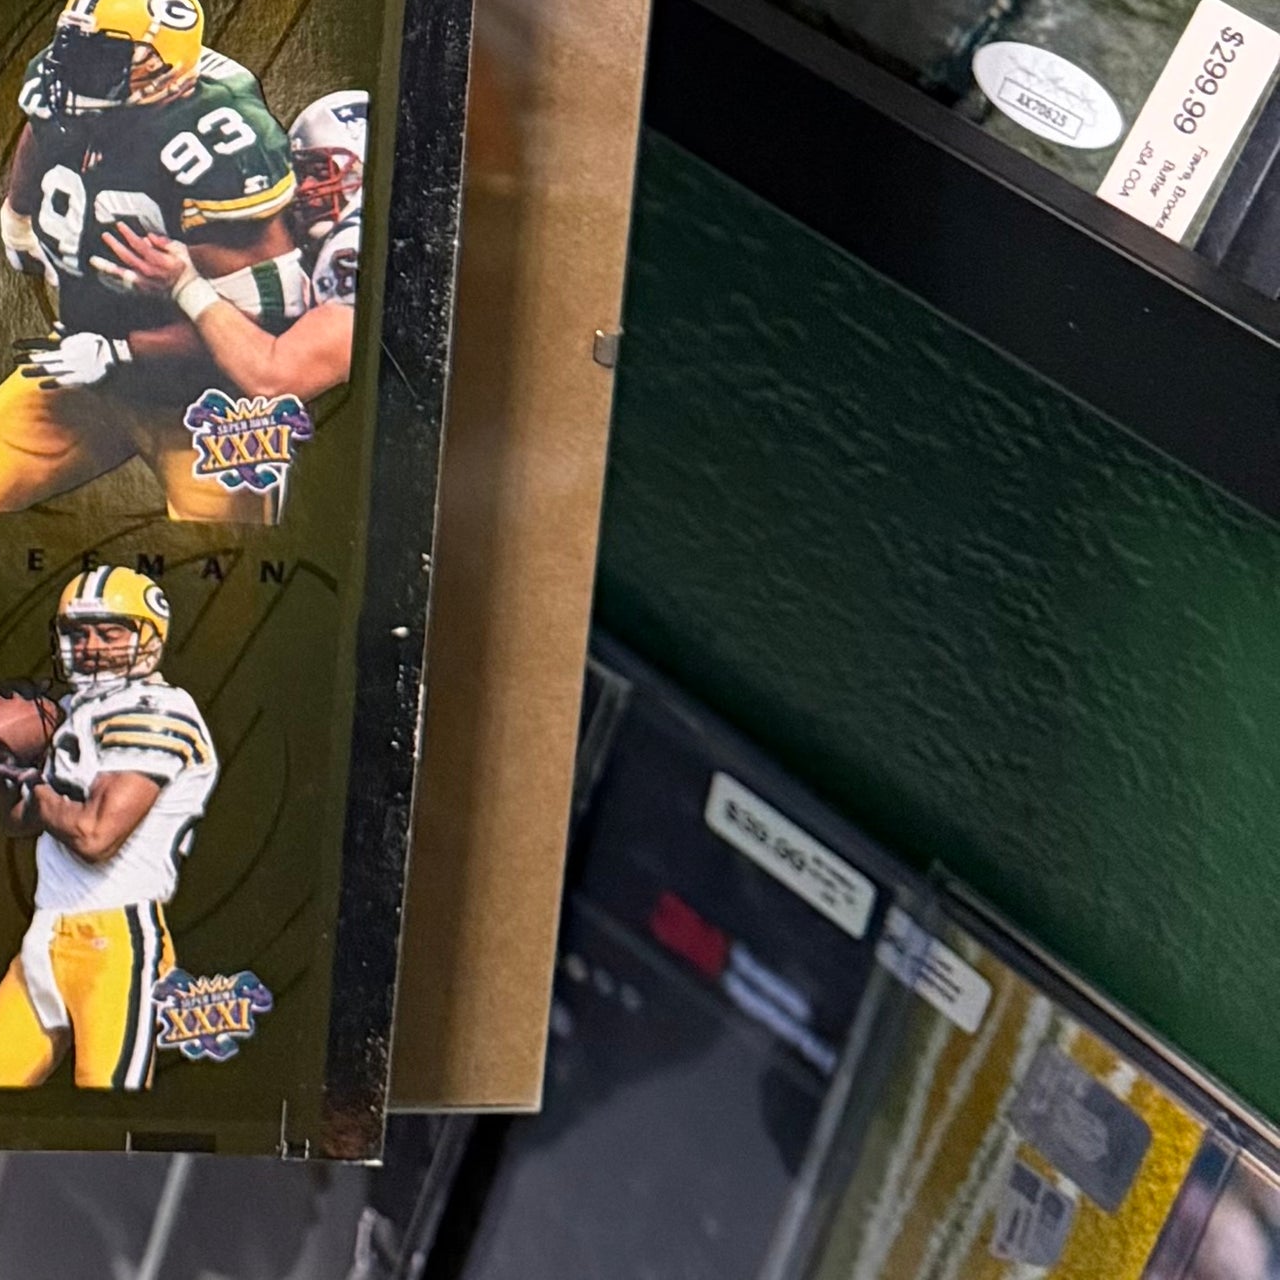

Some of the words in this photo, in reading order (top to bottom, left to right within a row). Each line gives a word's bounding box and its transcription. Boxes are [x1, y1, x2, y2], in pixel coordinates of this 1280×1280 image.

[1173, 26, 1245, 134] $299.99
[161, 107, 257, 184] 93
[201, 426, 291, 470] XXXI
[166, 999, 250, 1040] XXXI
